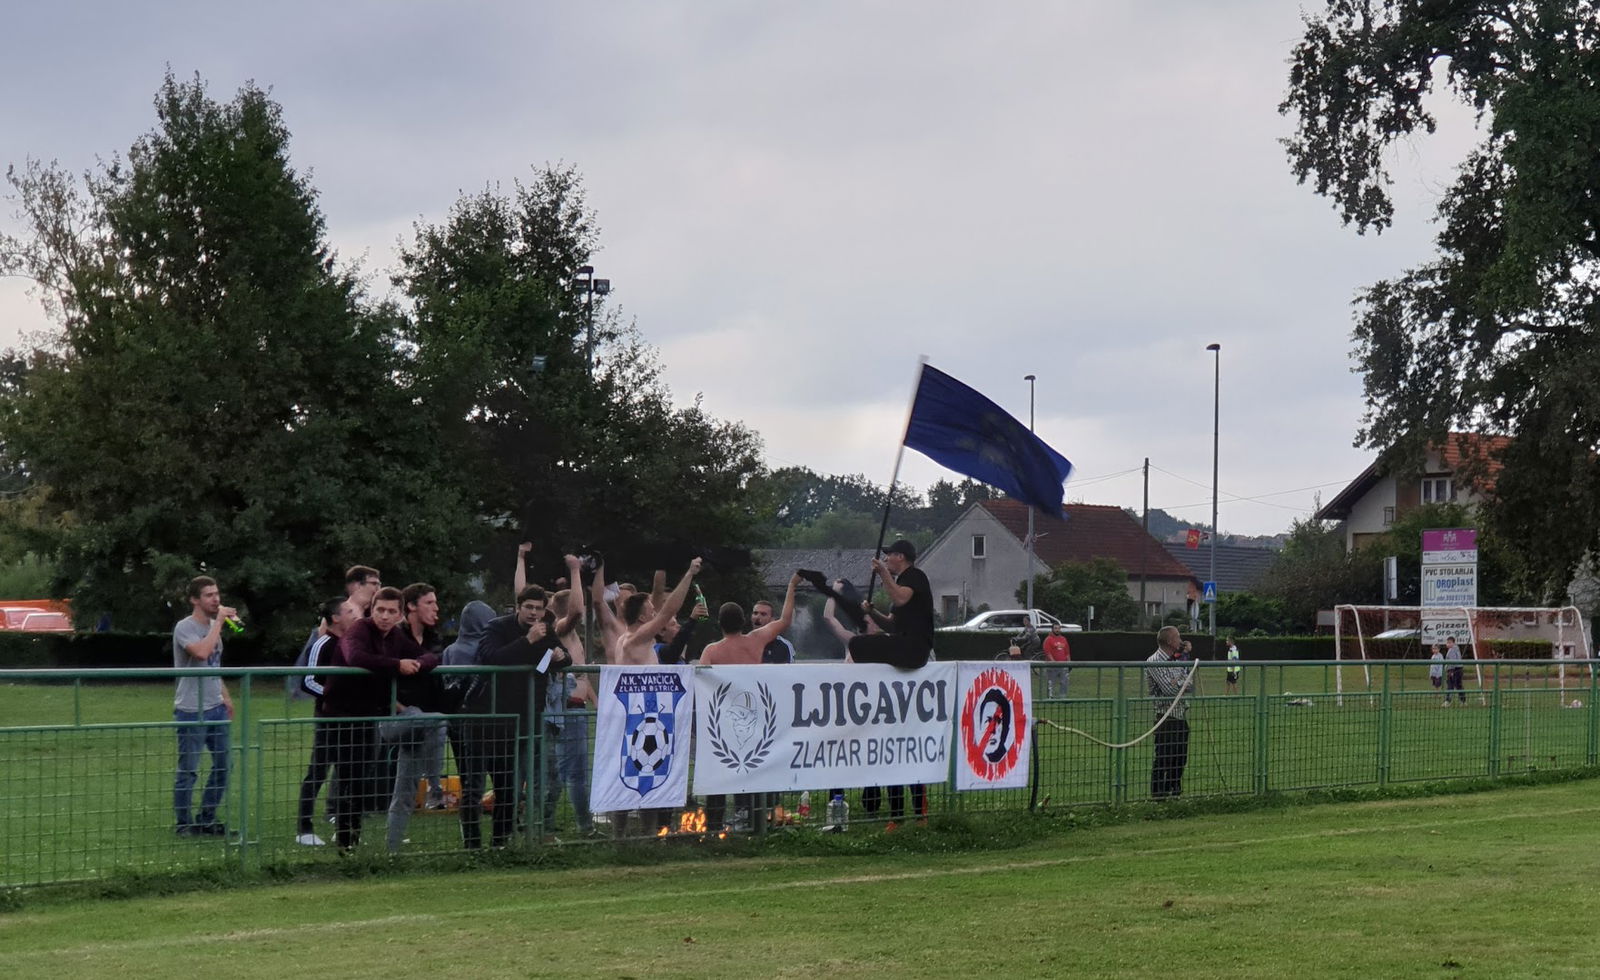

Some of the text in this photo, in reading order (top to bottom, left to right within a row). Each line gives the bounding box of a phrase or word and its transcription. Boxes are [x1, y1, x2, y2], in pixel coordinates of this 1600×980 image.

[1425, 567, 1474, 576] PVC STOLARIJA
[1435, 621, 1469, 631] pizzeri
[1436, 629, 1471, 637] oro-gor
[620, 675, 637, 686] N.K.
[791, 679, 948, 728] LJIGAVCI
[790, 735, 945, 769] ZLATAR BISTRICA
